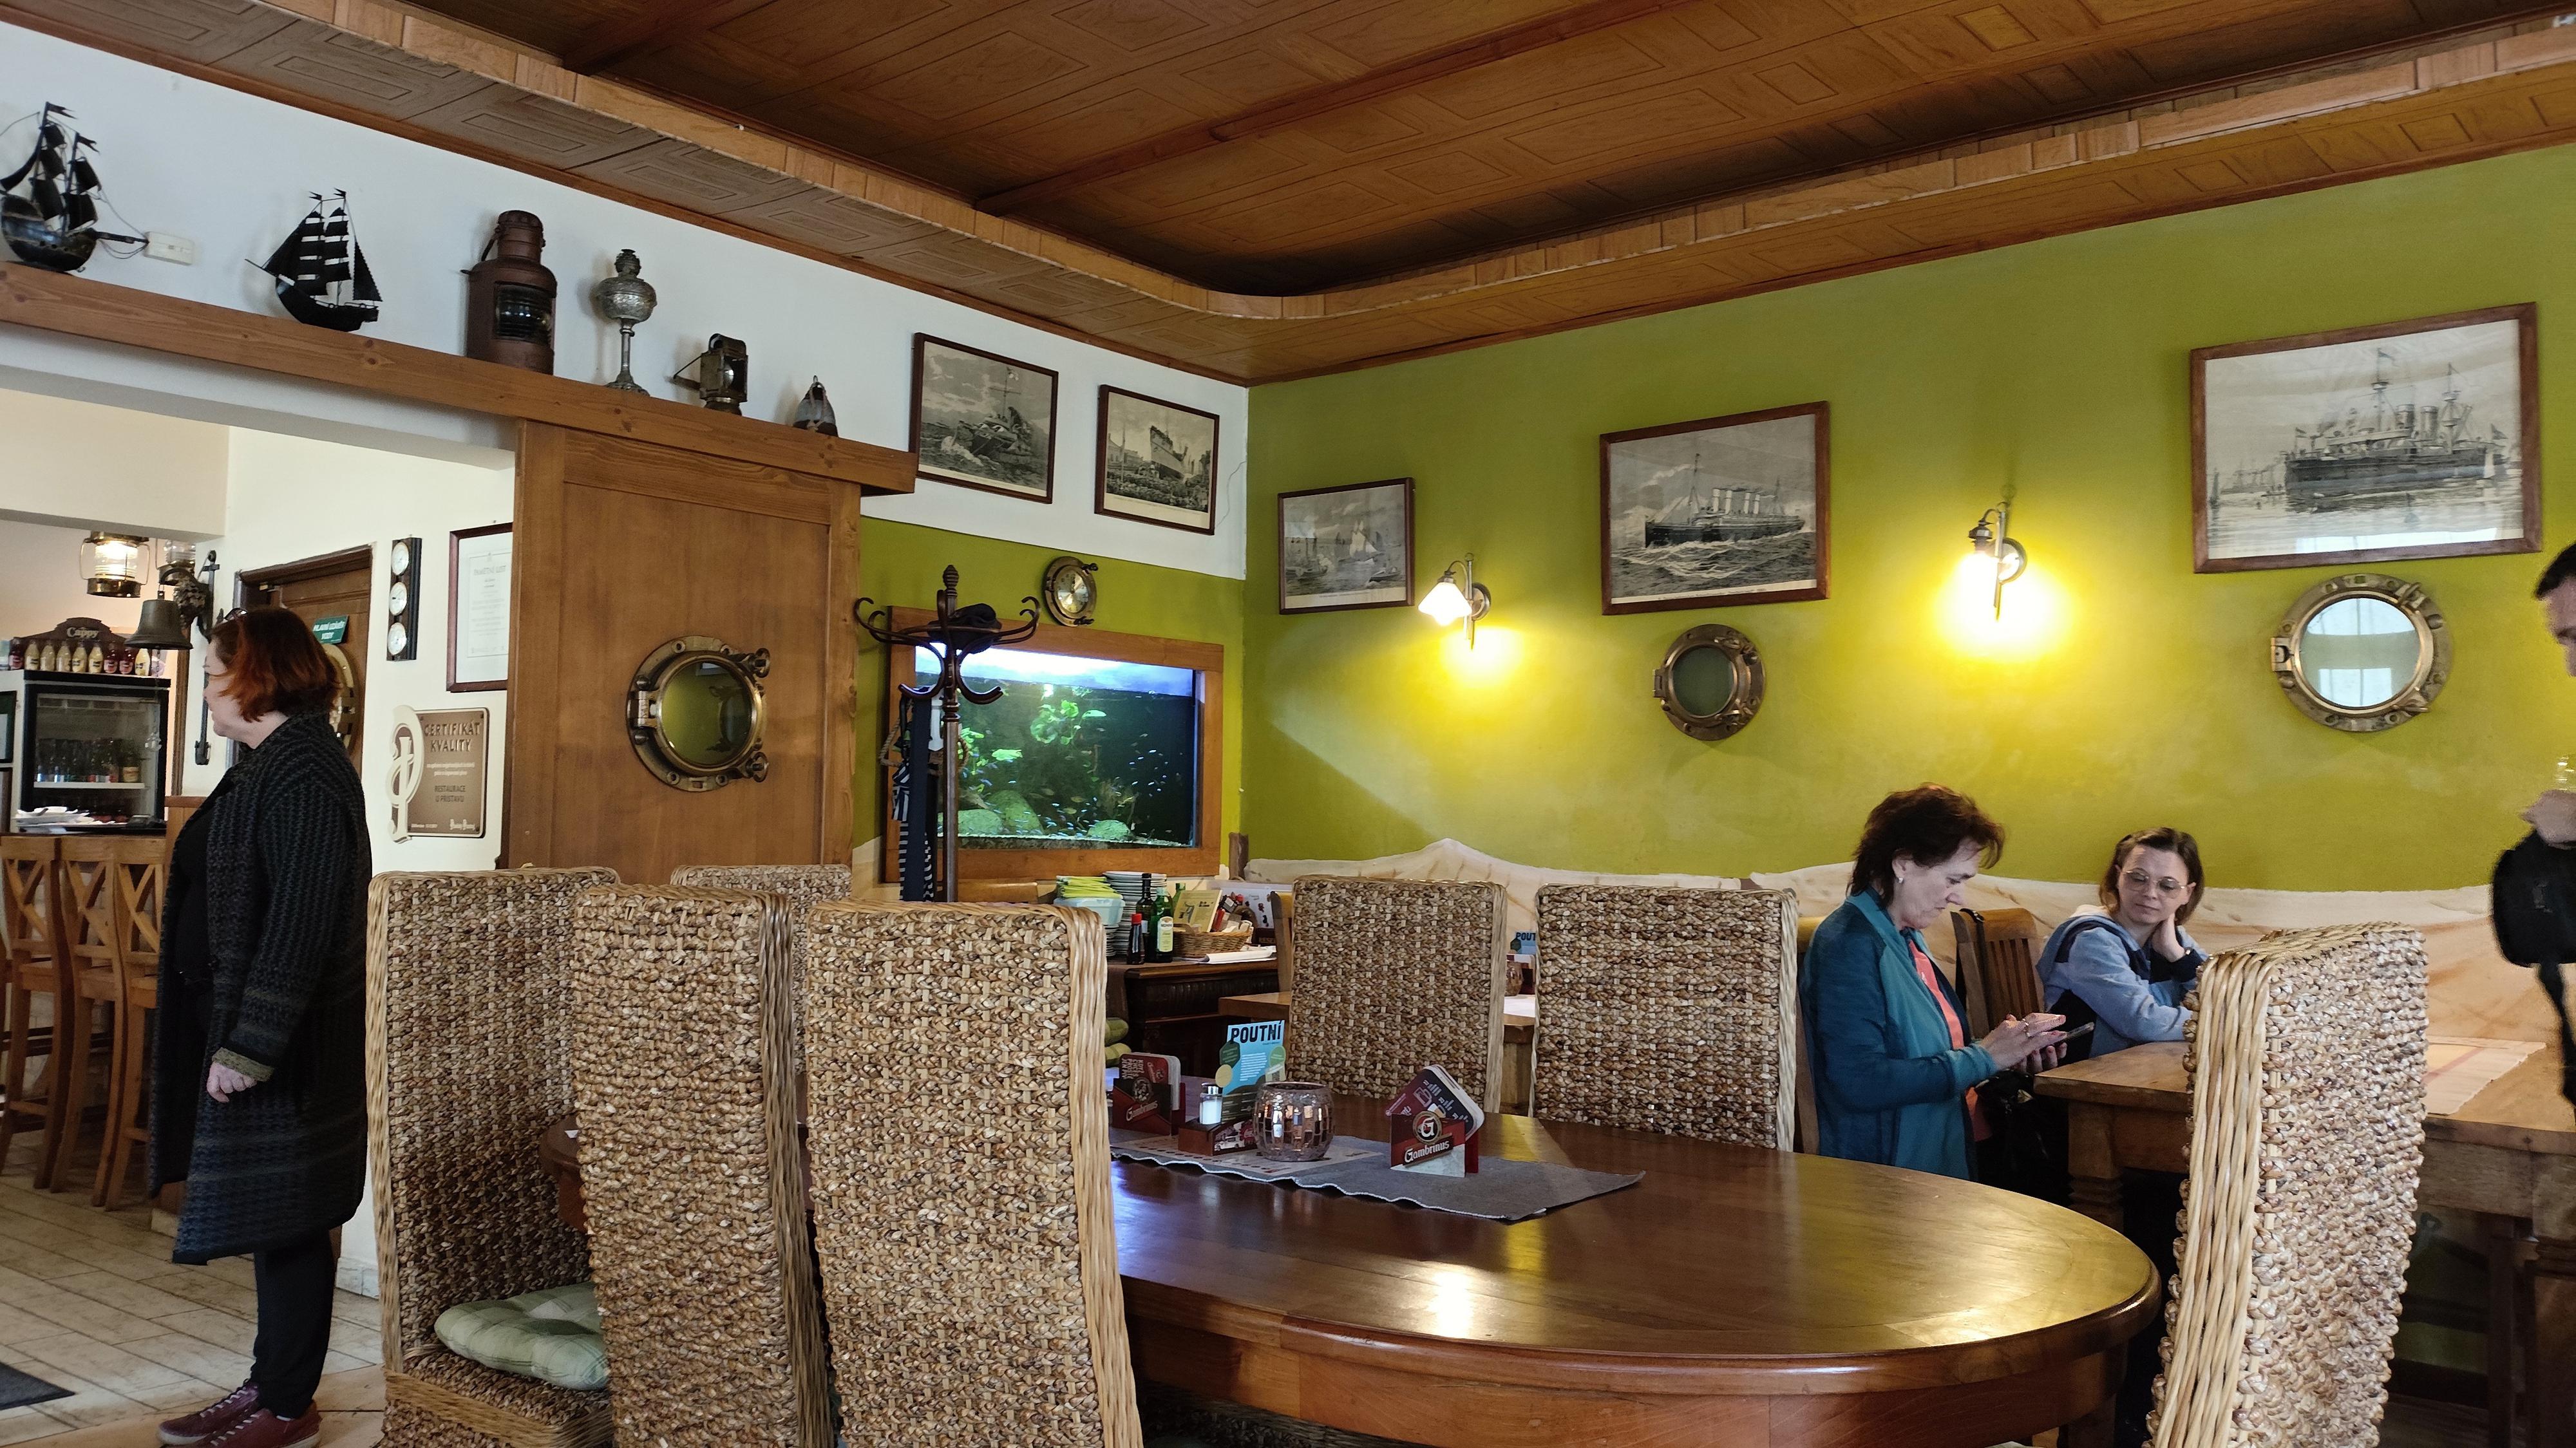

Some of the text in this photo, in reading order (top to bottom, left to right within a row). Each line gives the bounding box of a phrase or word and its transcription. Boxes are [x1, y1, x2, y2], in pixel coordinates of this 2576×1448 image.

[424, 719, 480, 737] CERTIFIKÁT
[430, 738, 472, 753] KVALITY
[1230, 1020, 1282, 1044] POUTNÍ
[1404, 1140, 1450, 1163] Gambrinus
